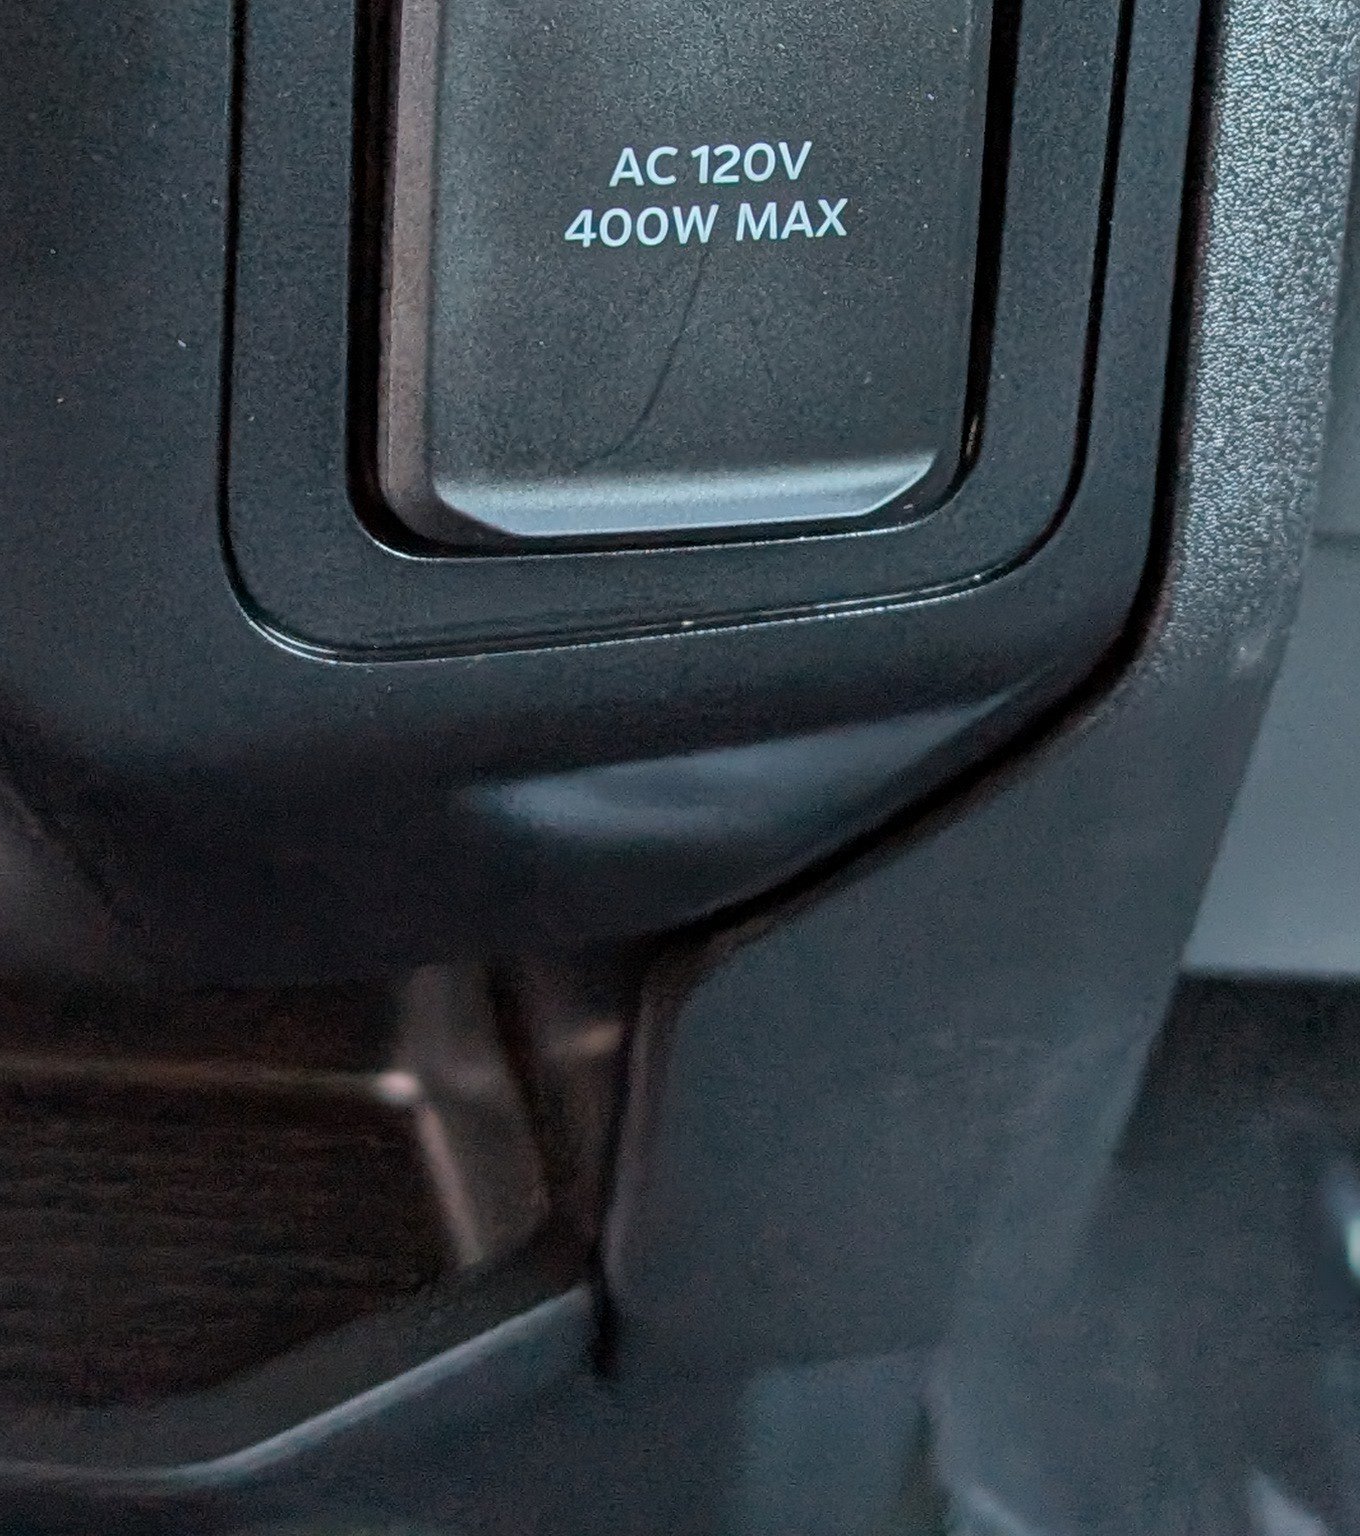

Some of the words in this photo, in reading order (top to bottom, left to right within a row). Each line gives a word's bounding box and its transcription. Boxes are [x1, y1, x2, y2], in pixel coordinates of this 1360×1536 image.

[608, 145, 679, 188] AC
[690, 140, 813, 185] 120V
[563, 203, 720, 249] 400W
[734, 197, 849, 242] MAX
